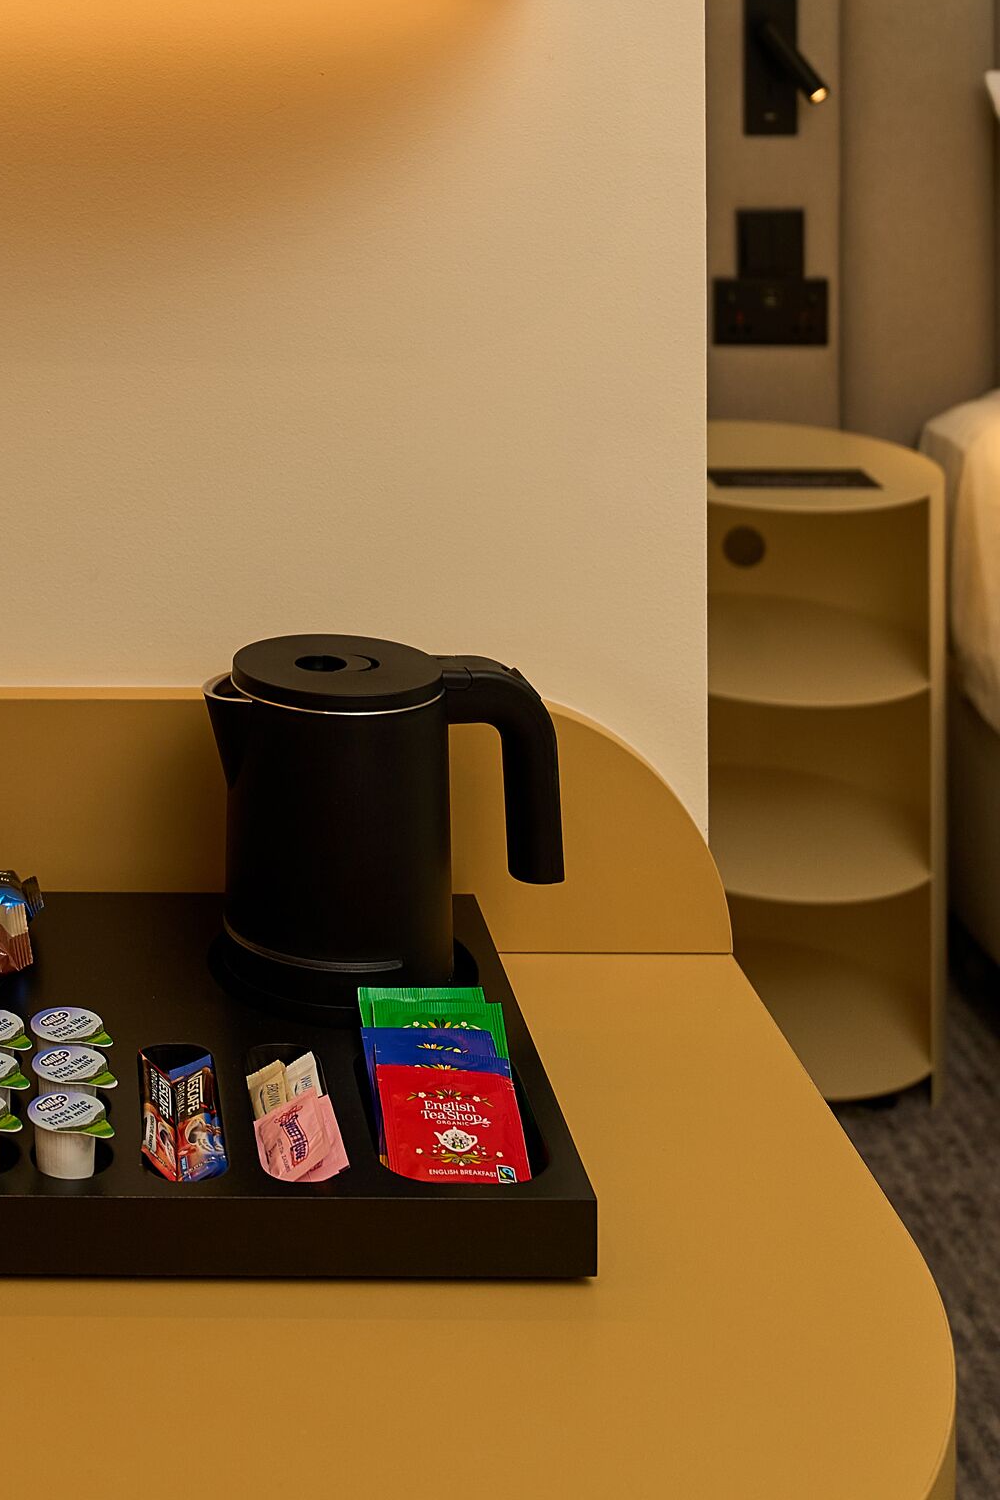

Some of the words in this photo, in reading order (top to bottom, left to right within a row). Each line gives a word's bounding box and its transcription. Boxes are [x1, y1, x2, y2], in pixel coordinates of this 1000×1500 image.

[46, 1023, 72, 1035] tastes
[70, 1015, 87, 1025] like
[54, 1029, 76, 1038] fresh
[77, 1019, 93, 1031] milk
[47, 1064, 73, 1076] tastes
[71, 1054, 89, 1065] like
[54, 1069, 77, 1079] fresh
[77, 1058, 95, 1070] milk
[177, 1081, 186, 1113] ORIGINAL
[266, 1082, 281, 1107] BROWN
[41, 1109, 70, 1122] tastes
[68, 1100, 87, 1110] like
[48, 1114, 74, 1126] fresh
[74, 1104, 93, 1116] milk
[421, 1110, 447, 1120] Tea
[447, 1109, 482, 1124] Shop
[424, 1100, 476, 1113] English
[460, 1169, 497, 1178] BREAKFAST
